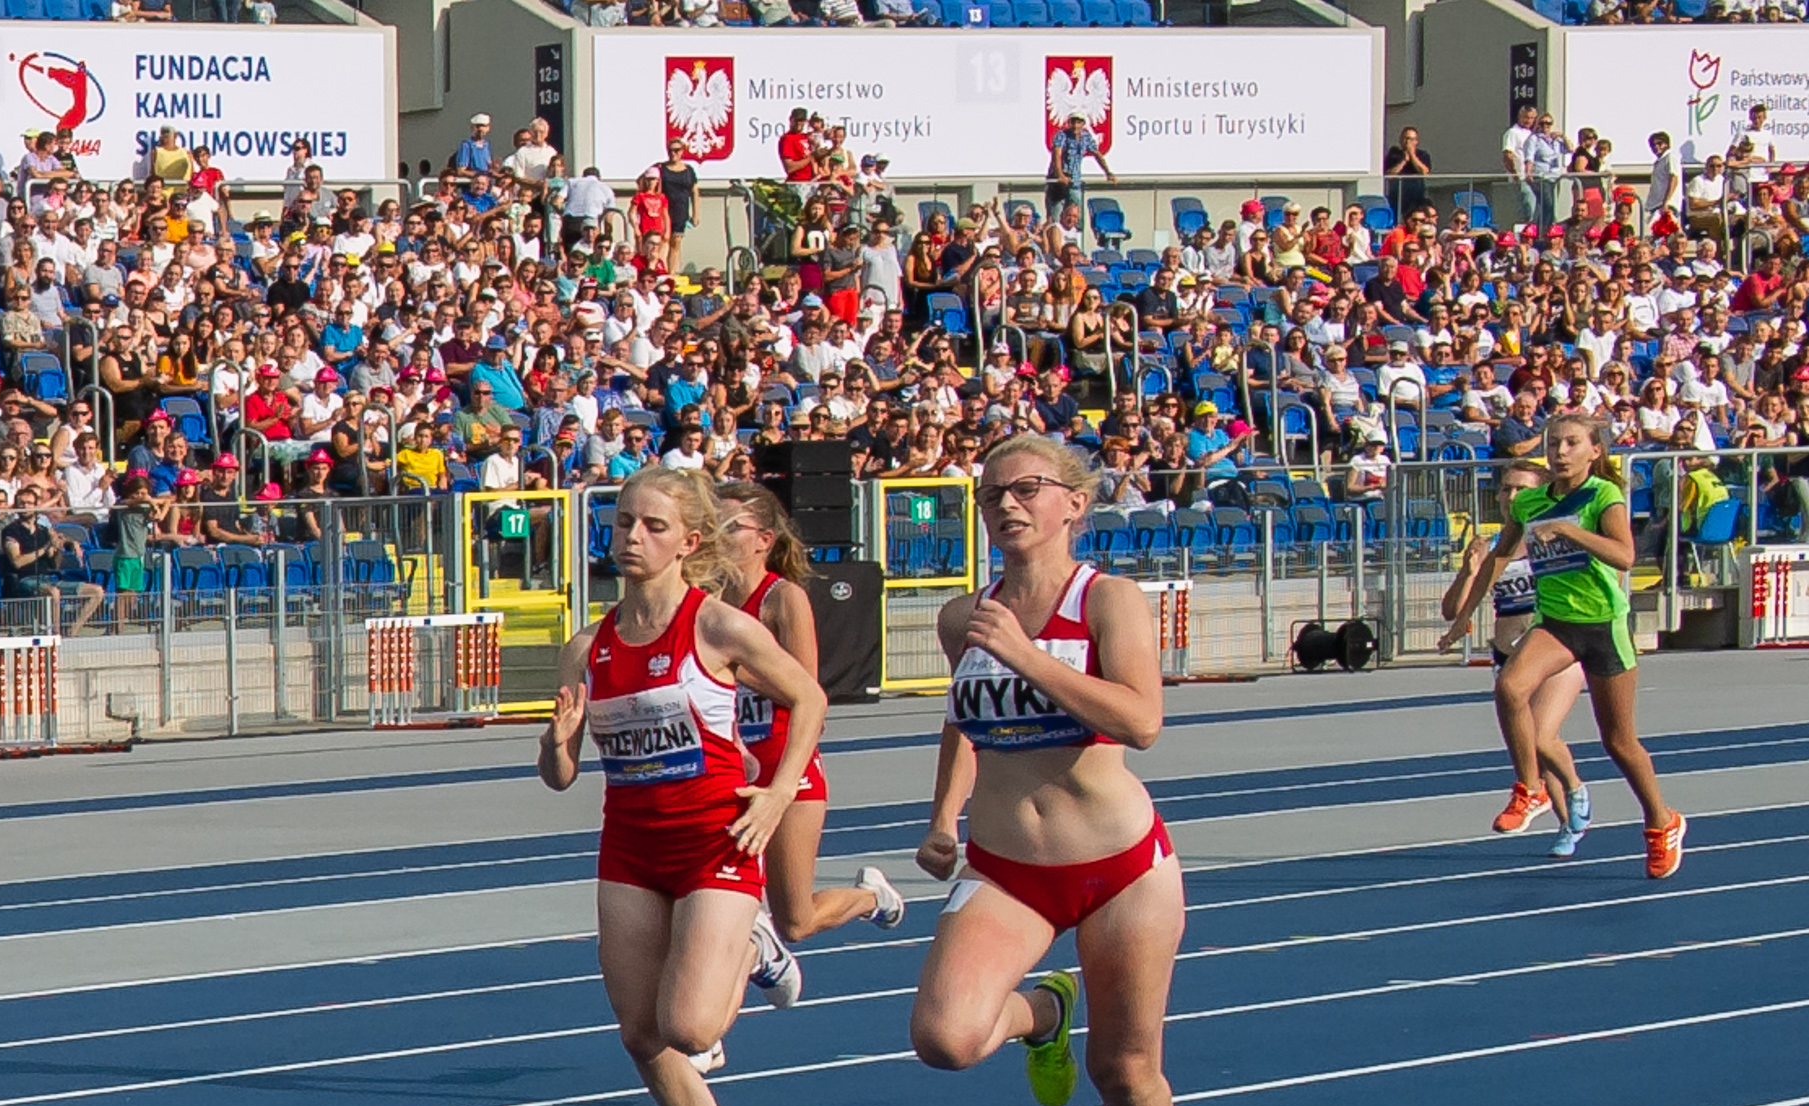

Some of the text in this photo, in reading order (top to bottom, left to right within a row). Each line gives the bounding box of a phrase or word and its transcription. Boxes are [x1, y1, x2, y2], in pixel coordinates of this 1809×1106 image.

[135, 54, 271, 82] FUNDACJA
[969, 51, 1008, 94] 13
[747, 78, 884, 100] Ministerstwo
[1125, 78, 1259, 98] Ministerstwo
[135, 92, 222, 119] KAMILI
[1125, 113, 1307, 140] Sportu i Turystyki
[70, 139, 101, 156] AMA
[916, 500, 932, 520] 18
[508, 513, 526, 534] 17
[951, 677, 1058, 719] WYK
